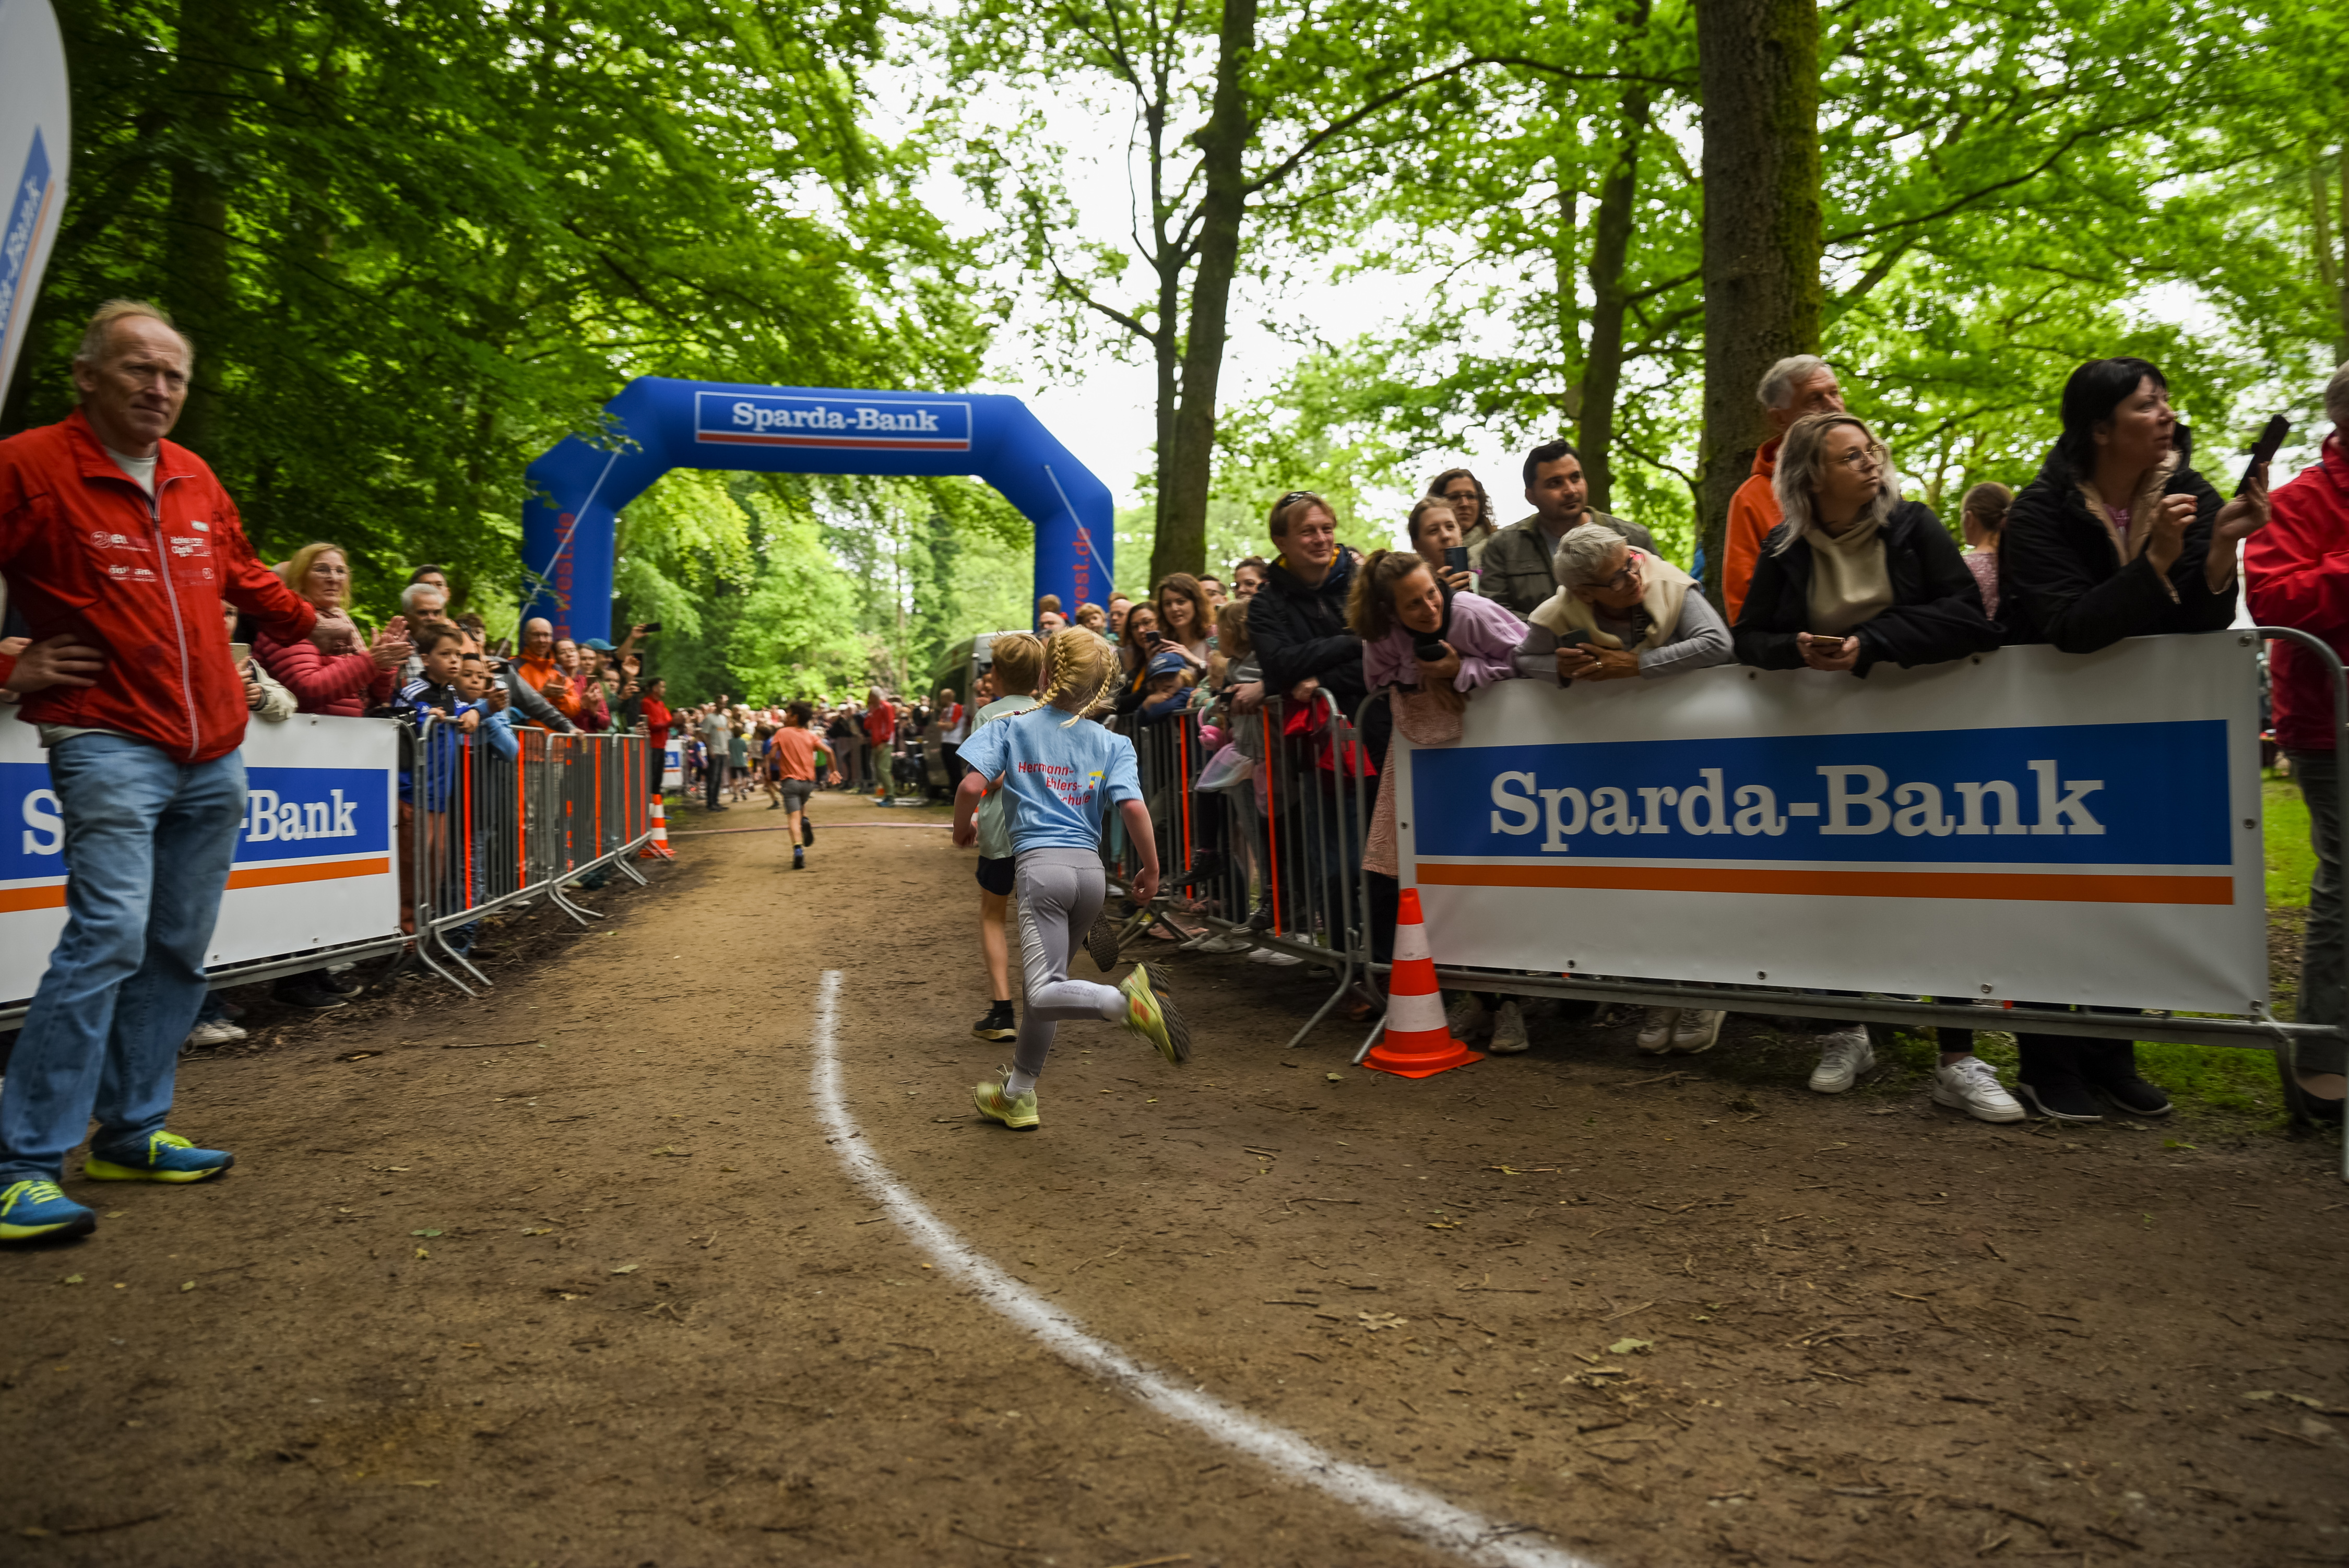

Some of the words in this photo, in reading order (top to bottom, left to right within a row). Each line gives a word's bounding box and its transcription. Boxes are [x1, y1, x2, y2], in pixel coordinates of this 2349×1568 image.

[732, 401, 939, 432] Sparda-Bank
[1018, 762, 1074, 776] Hermann-
[1046, 777, 1082, 791] Ehlers-
[1489, 759, 2107, 852] Sparda-Bank
